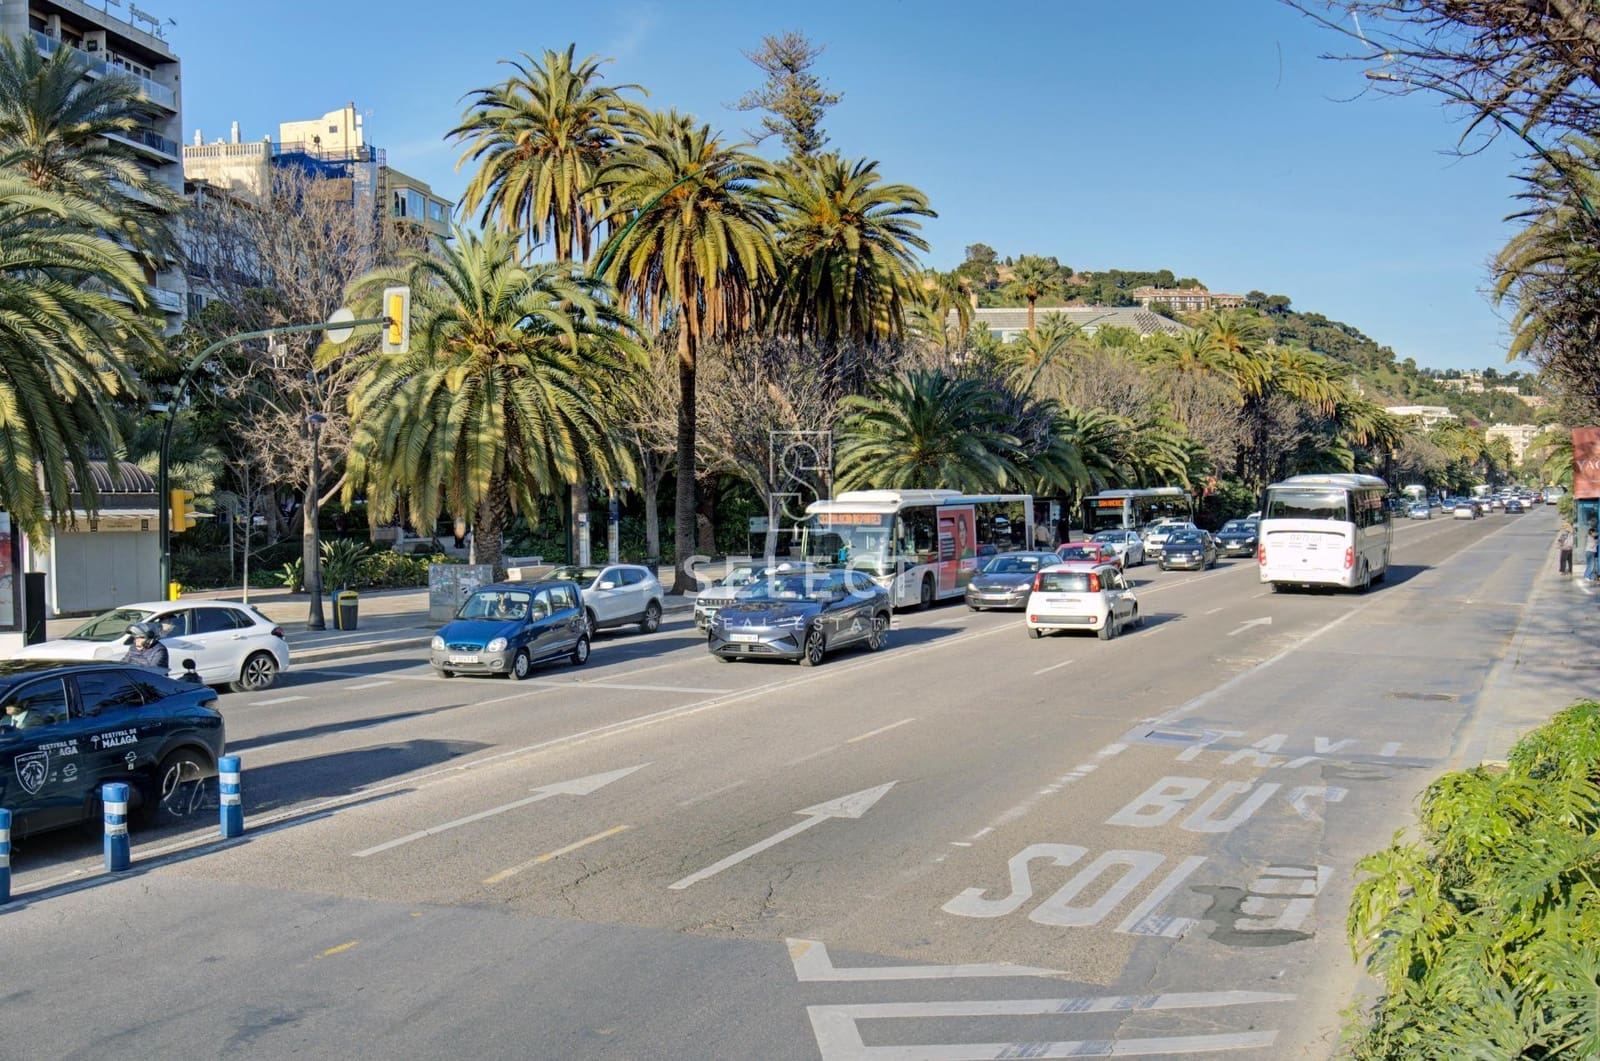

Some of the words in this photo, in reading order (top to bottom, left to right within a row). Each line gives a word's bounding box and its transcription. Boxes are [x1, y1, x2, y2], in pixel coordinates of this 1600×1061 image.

[101, 730, 128, 740] FESTIVAL
[129, 727, 137, 735] DE
[39, 741, 67, 750] FESTIVAL
[1106, 776, 1349, 833] BUS
